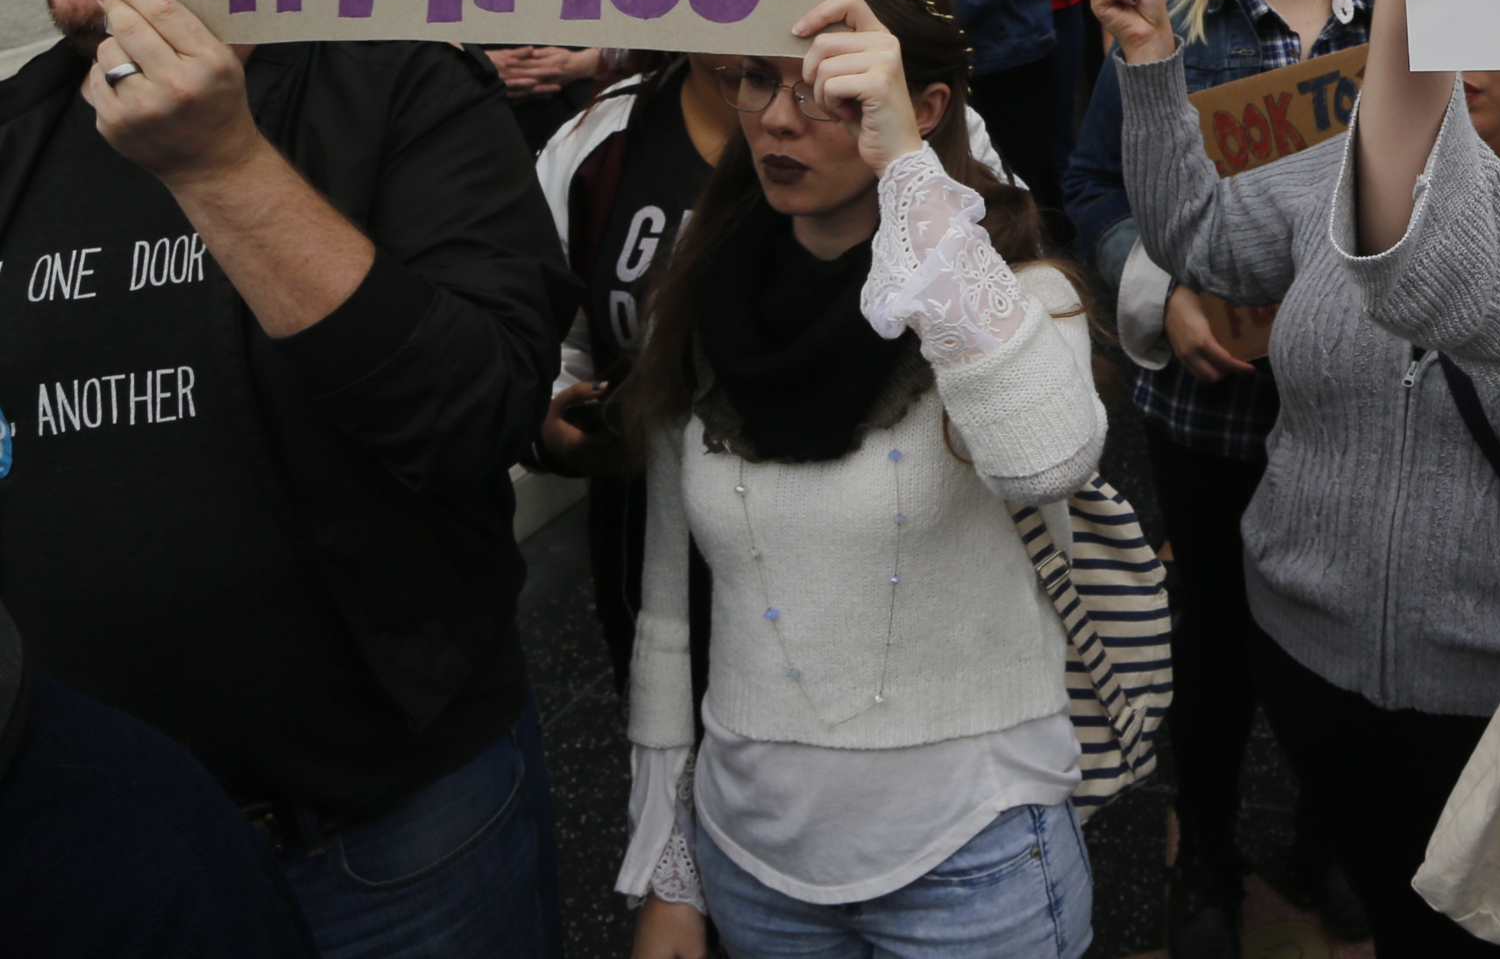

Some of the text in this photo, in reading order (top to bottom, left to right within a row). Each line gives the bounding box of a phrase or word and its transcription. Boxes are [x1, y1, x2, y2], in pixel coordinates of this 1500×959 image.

[1214, 91, 1308, 175] OOK
[28, 247, 102, 302] ONE
[38, 365, 196, 436] ANOTHER
